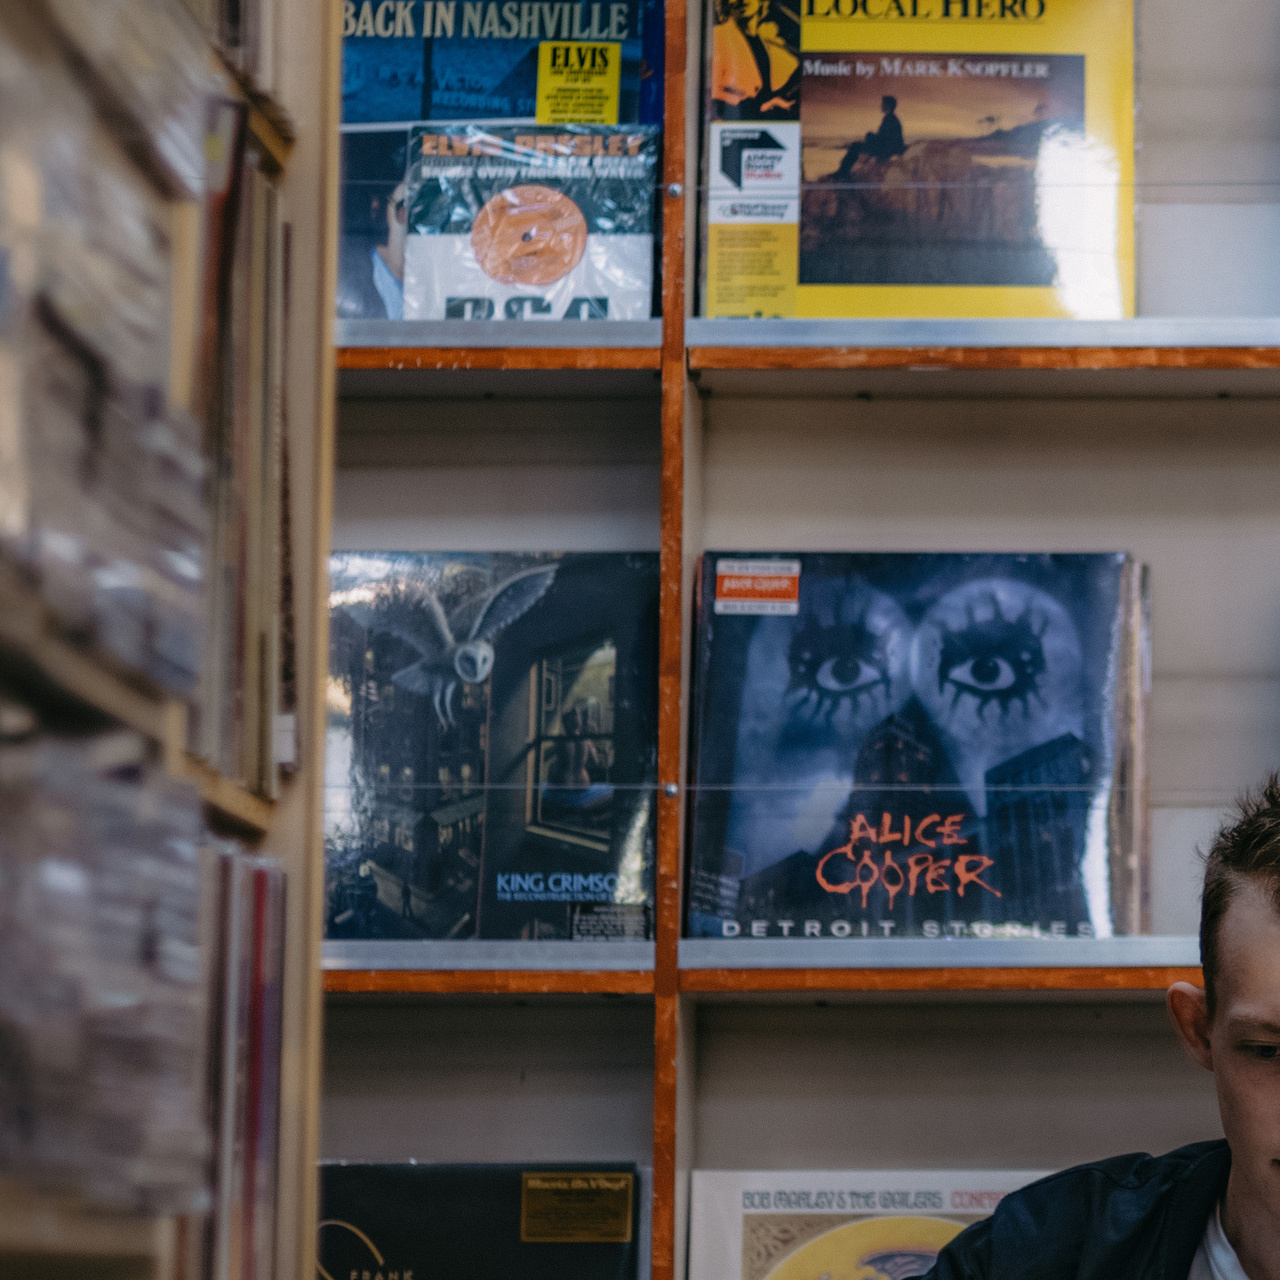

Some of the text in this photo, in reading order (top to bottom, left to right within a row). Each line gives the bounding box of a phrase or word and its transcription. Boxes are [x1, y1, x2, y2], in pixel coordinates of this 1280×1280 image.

[342, 0, 629, 40] BACK IN NASHVILLE
[551, 46, 609, 68] ELVIS
[803, 57, 1050, 80] Music by MARK KNOPFLER
[850, 813, 968, 847] ALICE
[496, 872, 621, 893] KING CRIMSO
[816, 842, 1002, 910] COOPER
[722, 919, 897, 937] DETROIT
[742, 1190, 772, 1209] BOB
